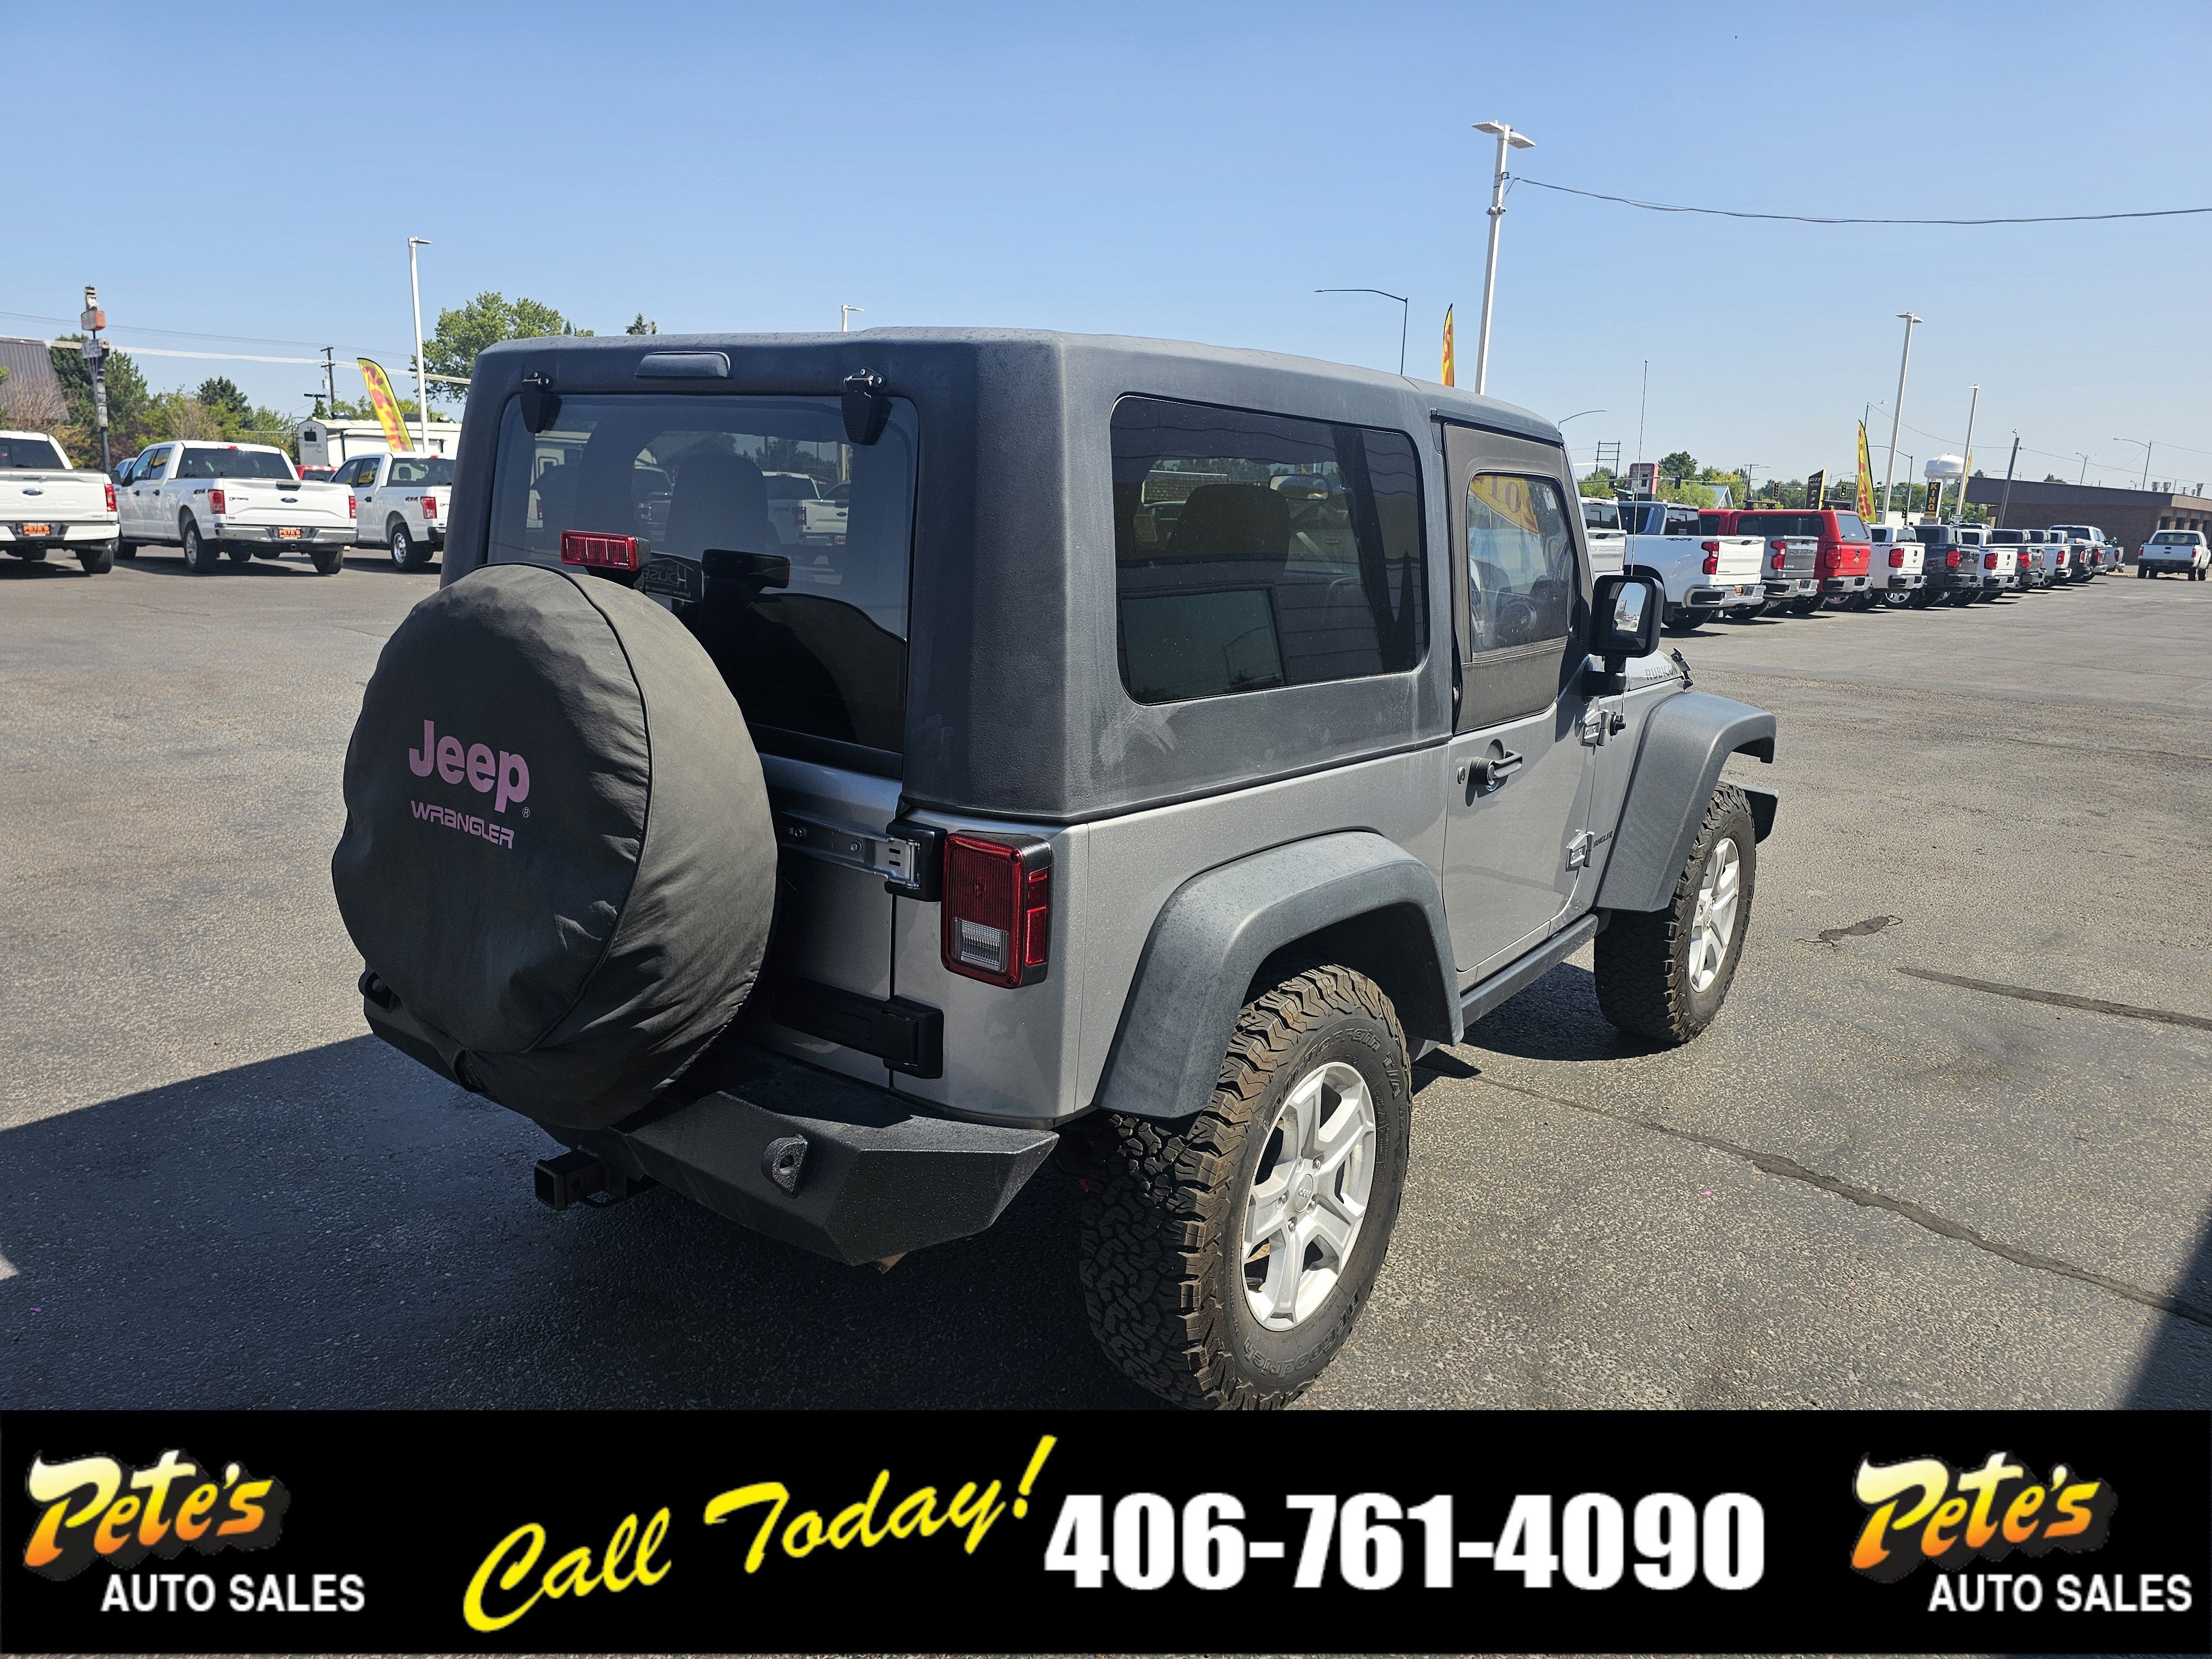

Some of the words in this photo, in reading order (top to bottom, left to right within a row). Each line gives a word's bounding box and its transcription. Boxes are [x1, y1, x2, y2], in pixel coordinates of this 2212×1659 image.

[1928, 483, 1938, 511] KING
[1645, 664, 1678, 681] RUBICON
[409, 719, 530, 813] Jeep
[411, 800, 515, 849] WRANGLER
[1244, 1288, 1359, 1379] BFGoodrich
